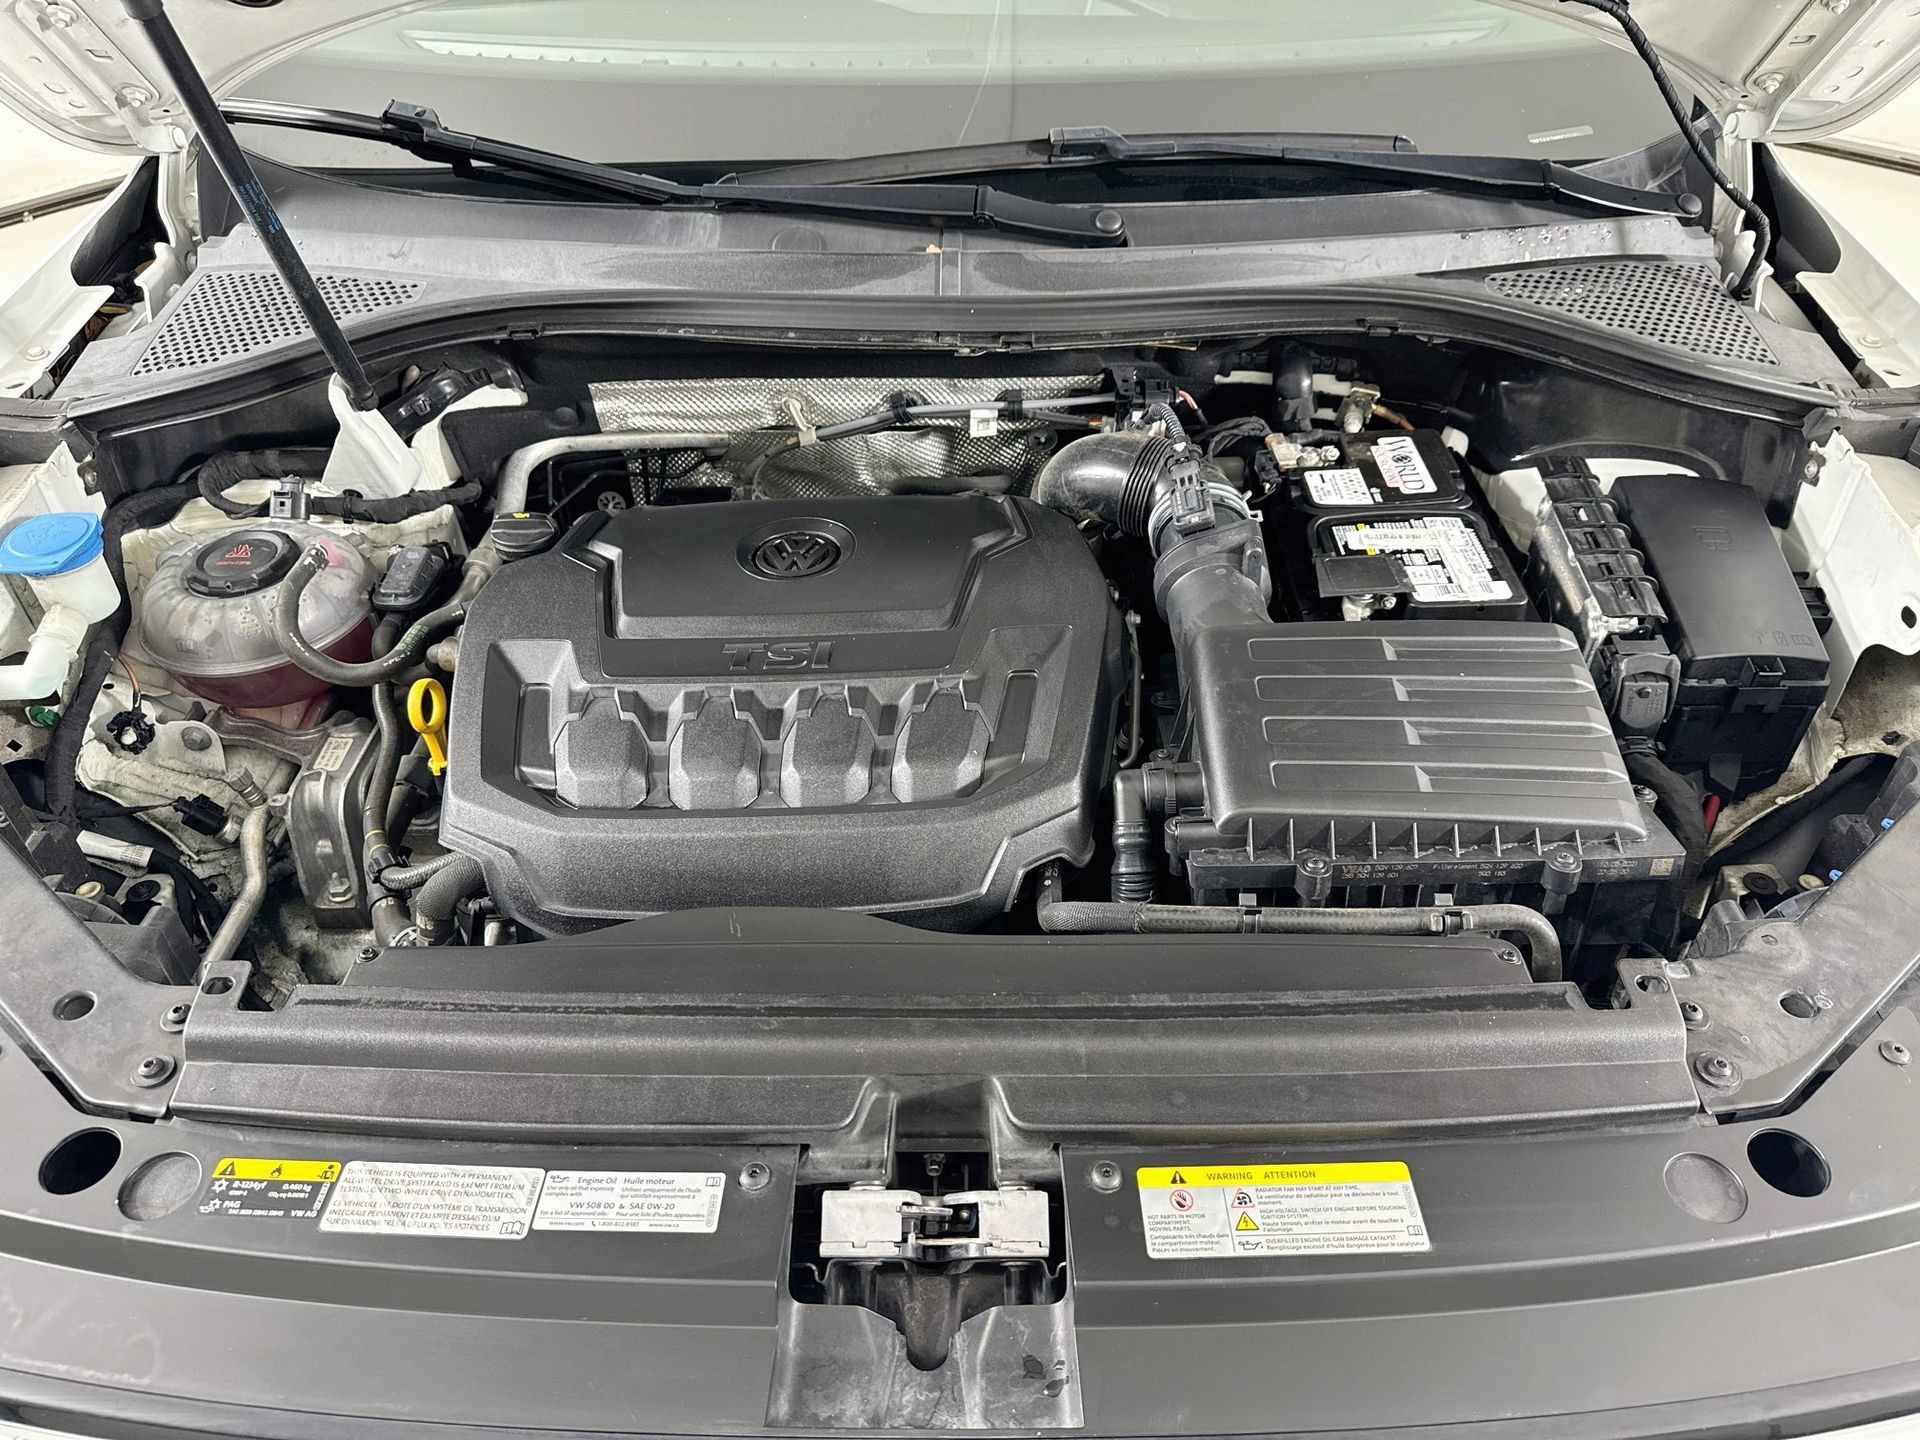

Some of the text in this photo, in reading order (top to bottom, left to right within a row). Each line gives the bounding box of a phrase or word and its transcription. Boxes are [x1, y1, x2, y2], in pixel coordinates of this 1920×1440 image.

[722, 641, 835, 670] TSI
[1207, 1170, 1316, 1180] WARNING ATTENTION
[578, 1177, 604, 1185] Engine
[475, 1206, 527, 1214] TRANSMISSION
